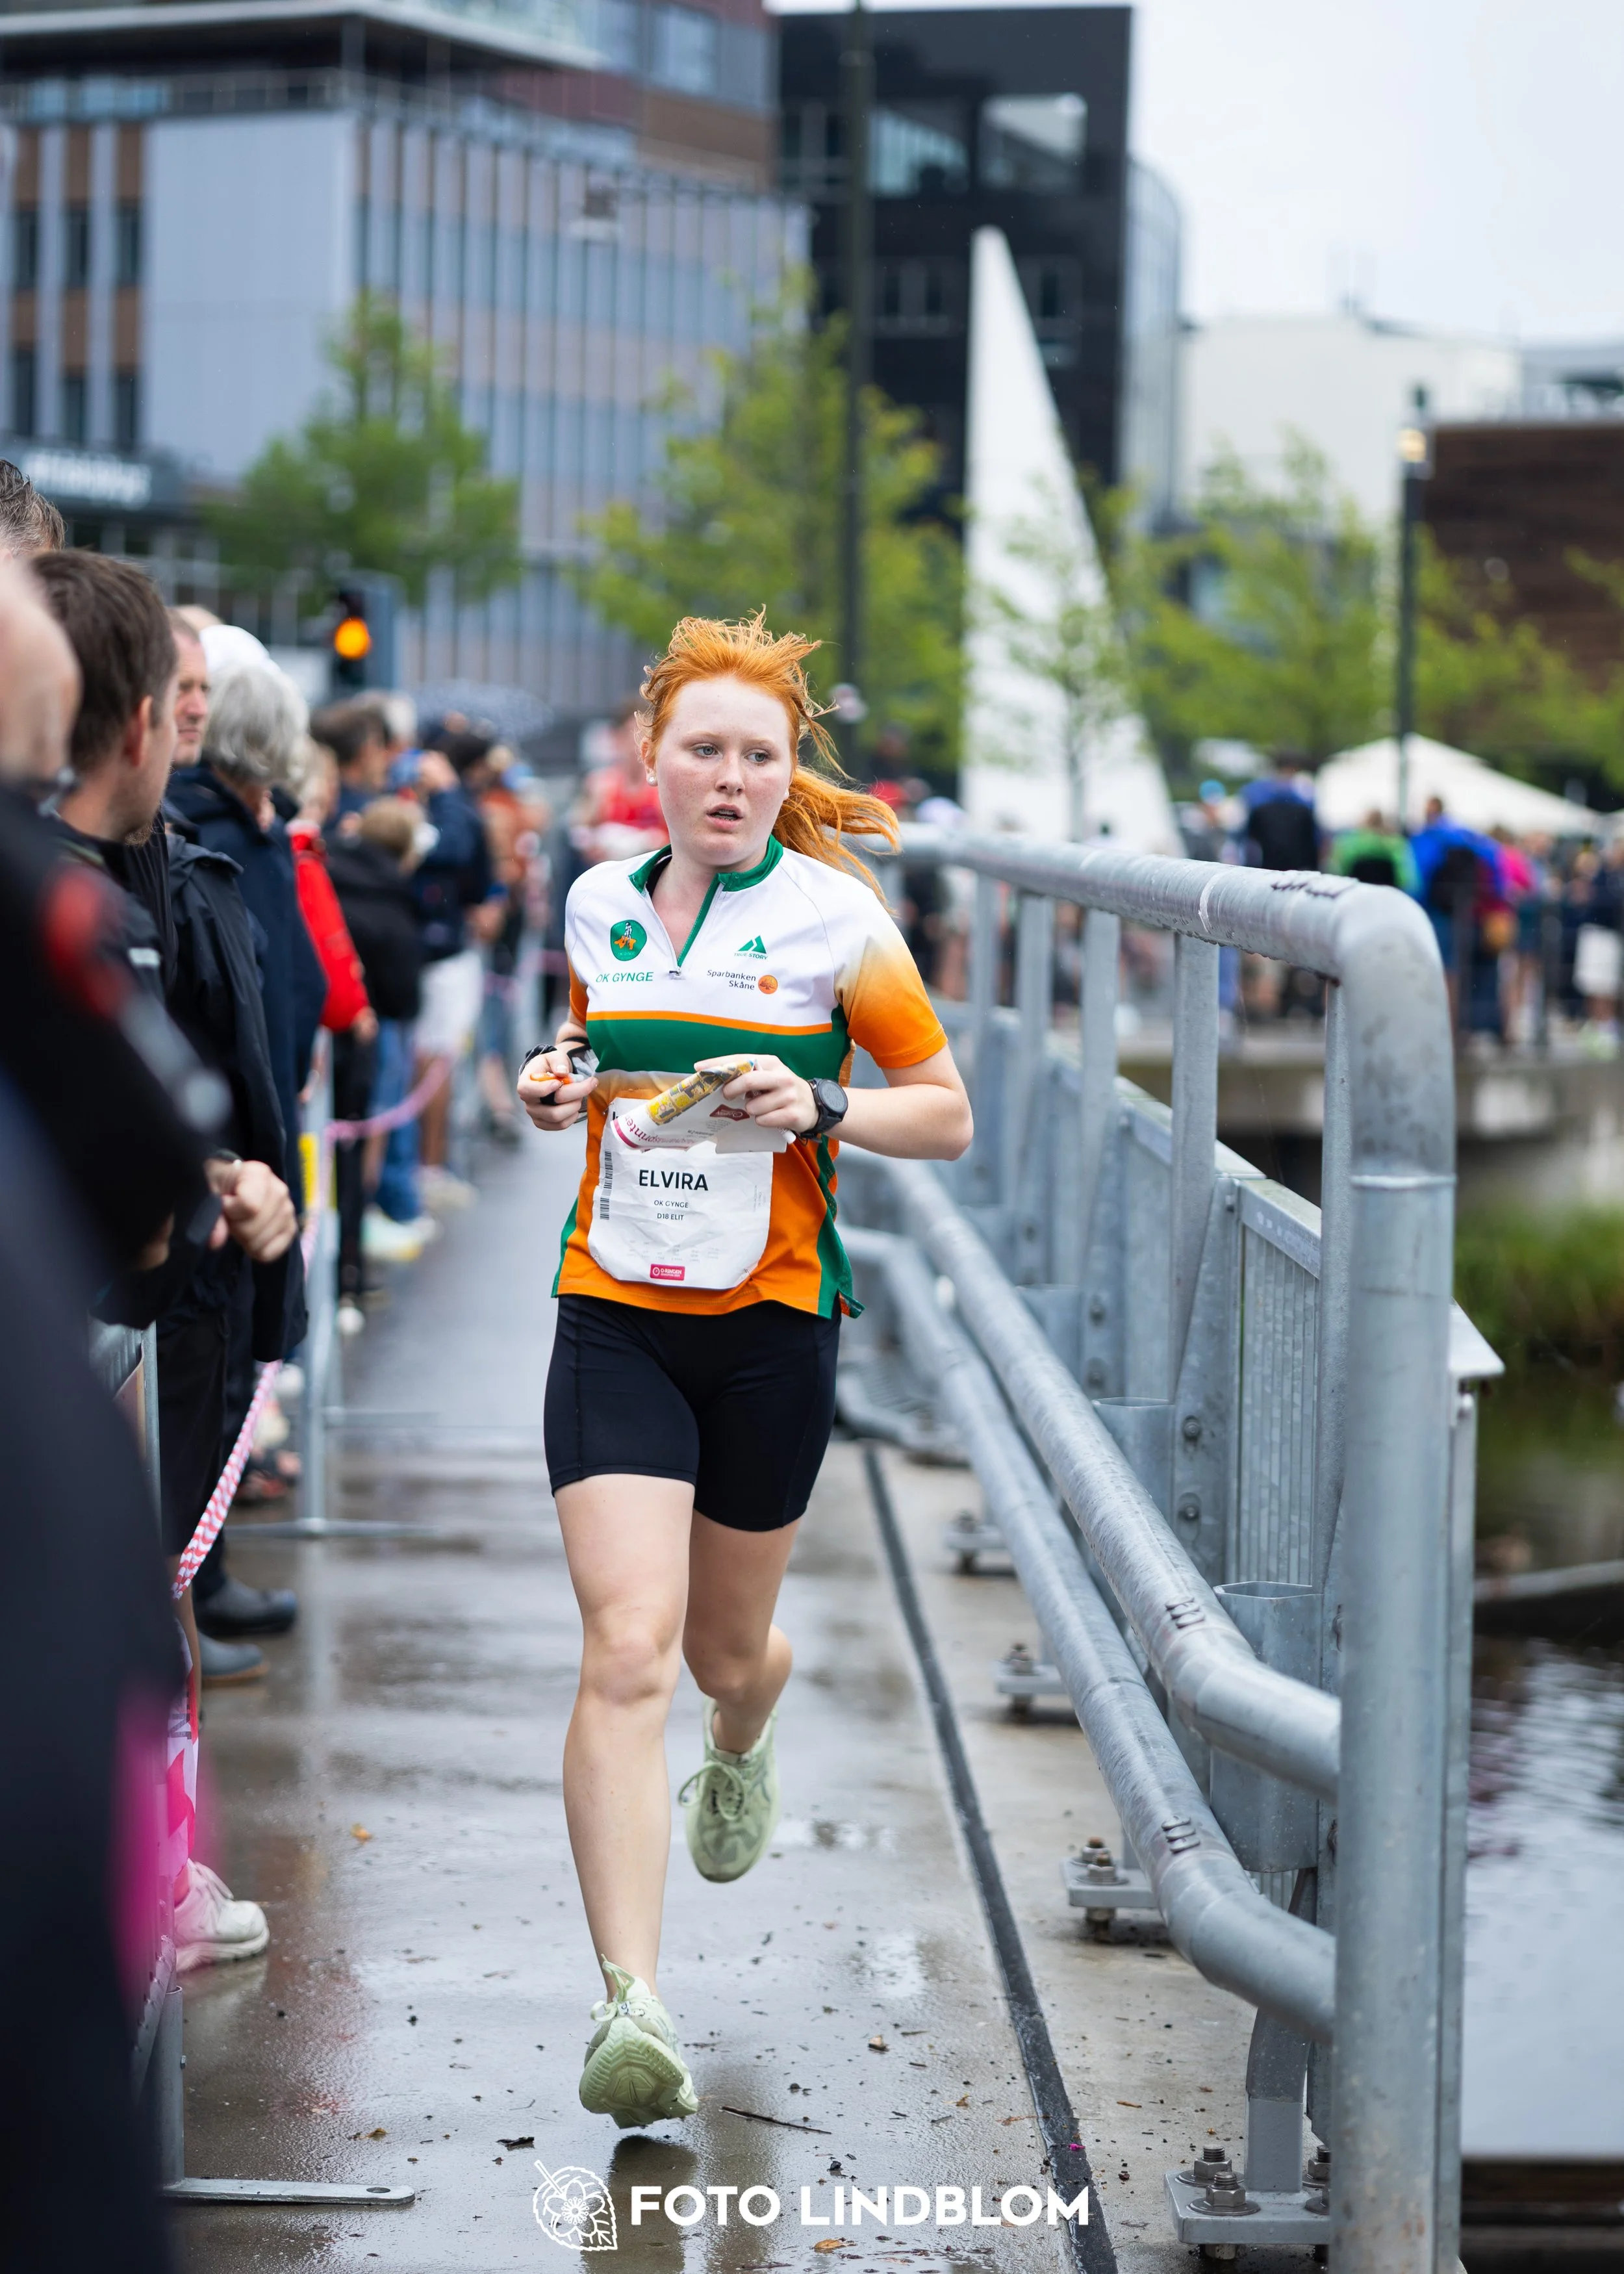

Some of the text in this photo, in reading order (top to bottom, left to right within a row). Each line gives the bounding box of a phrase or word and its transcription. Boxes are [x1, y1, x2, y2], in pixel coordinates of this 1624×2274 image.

[596, 972, 653, 982] OK GYNGE
[707, 969, 756, 982] Sparbanken
[729, 980, 755, 990] Skåne
[639, 1169, 708, 1191] ELVIRA
